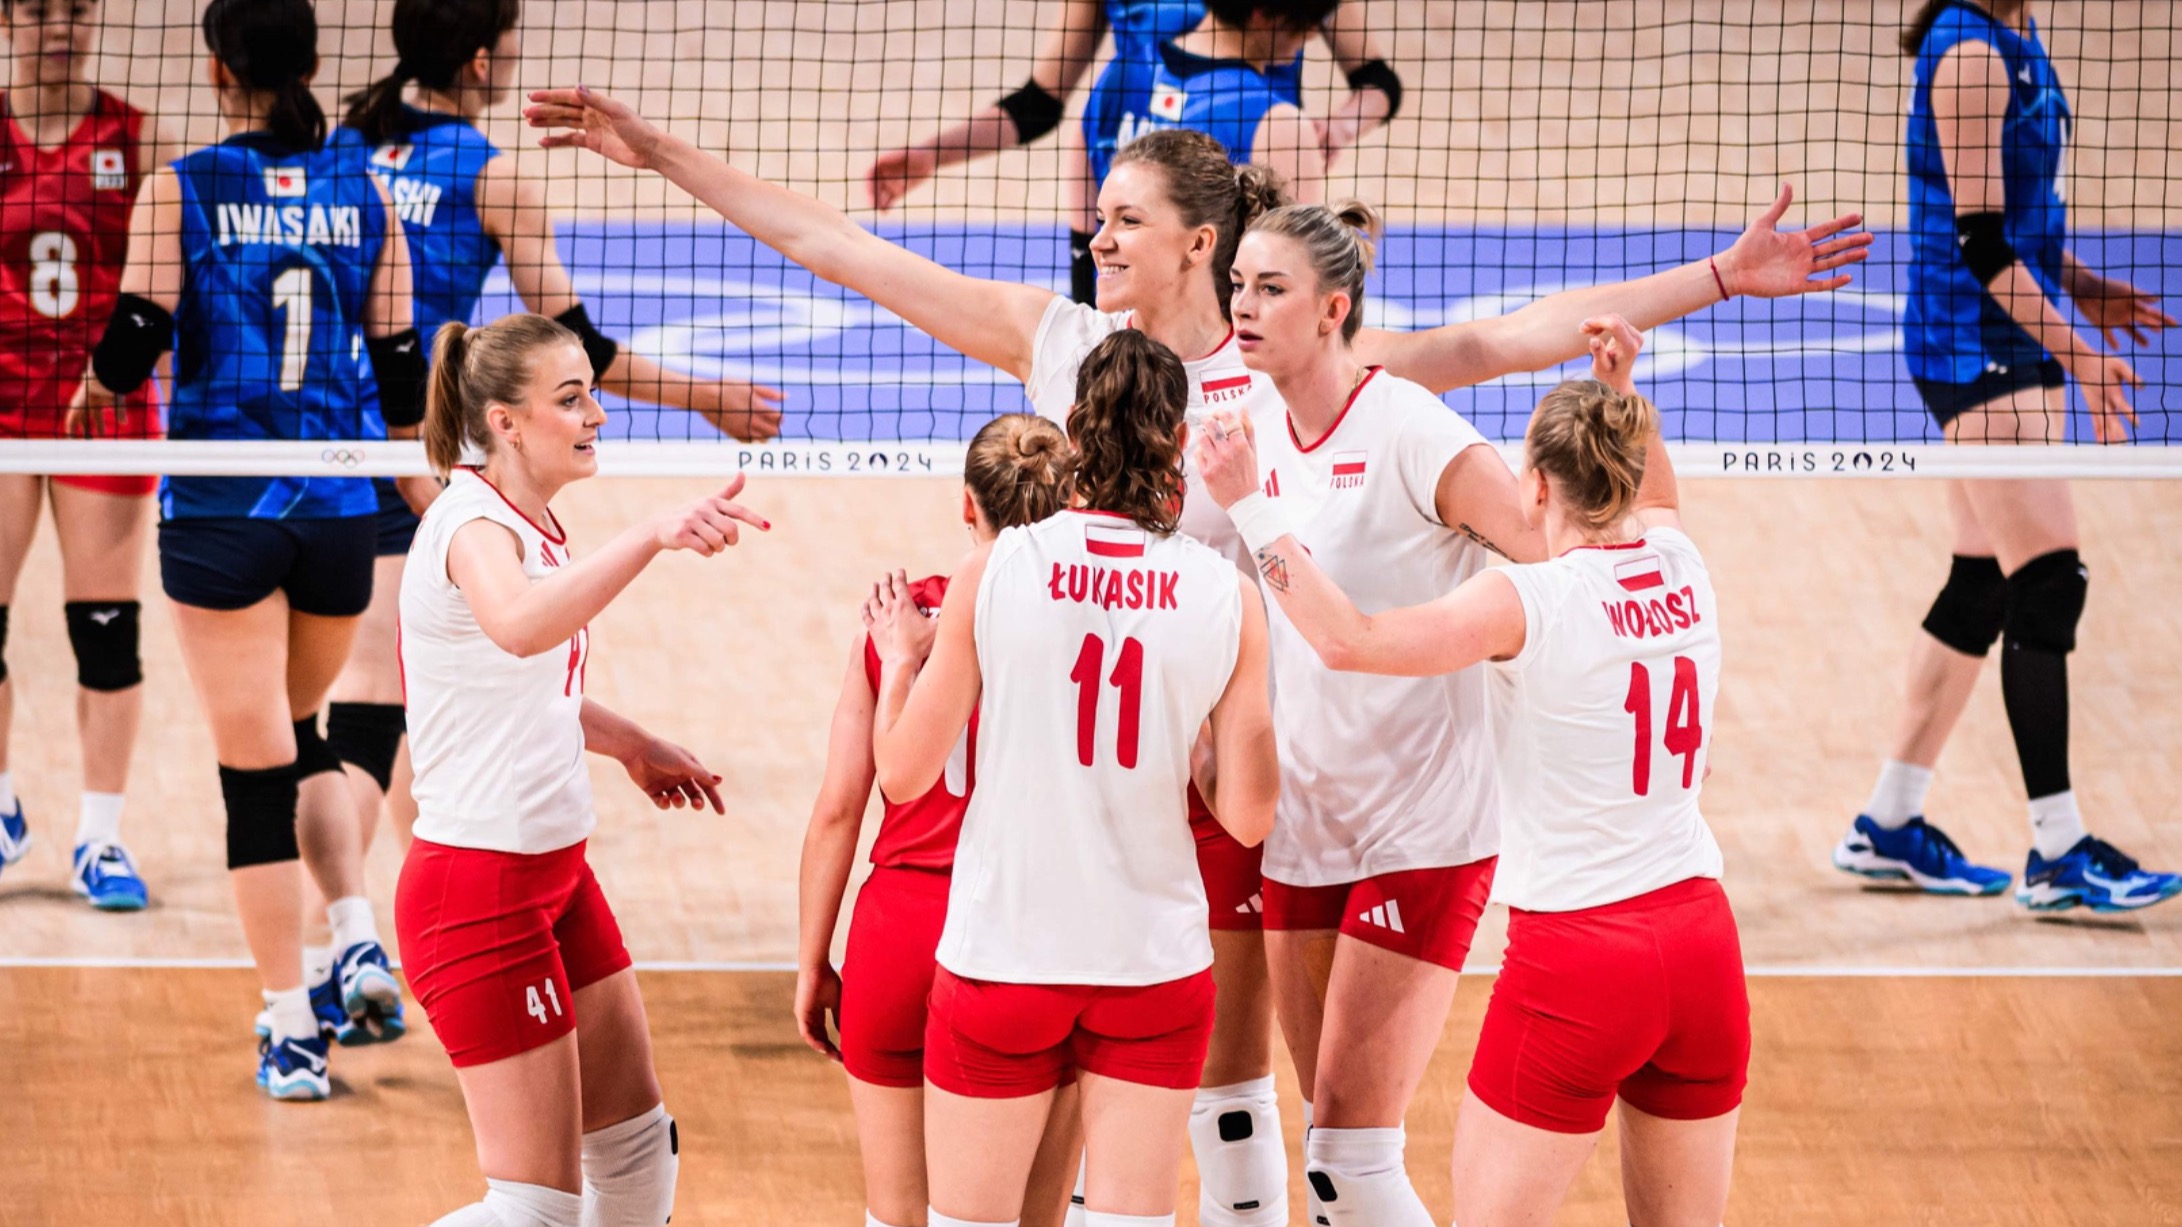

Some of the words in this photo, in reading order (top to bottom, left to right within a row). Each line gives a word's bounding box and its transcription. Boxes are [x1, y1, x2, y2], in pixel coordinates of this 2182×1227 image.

[217, 203, 361, 248] IWASAKI
[30, 231, 79, 318] 8
[272, 267, 312, 392] 1
[1048, 562, 1180, 611] ŁUKASIK
[1070, 632, 1144, 770] 11
[1624, 656, 1703, 797] 14
[526, 977, 563, 1024] 41
